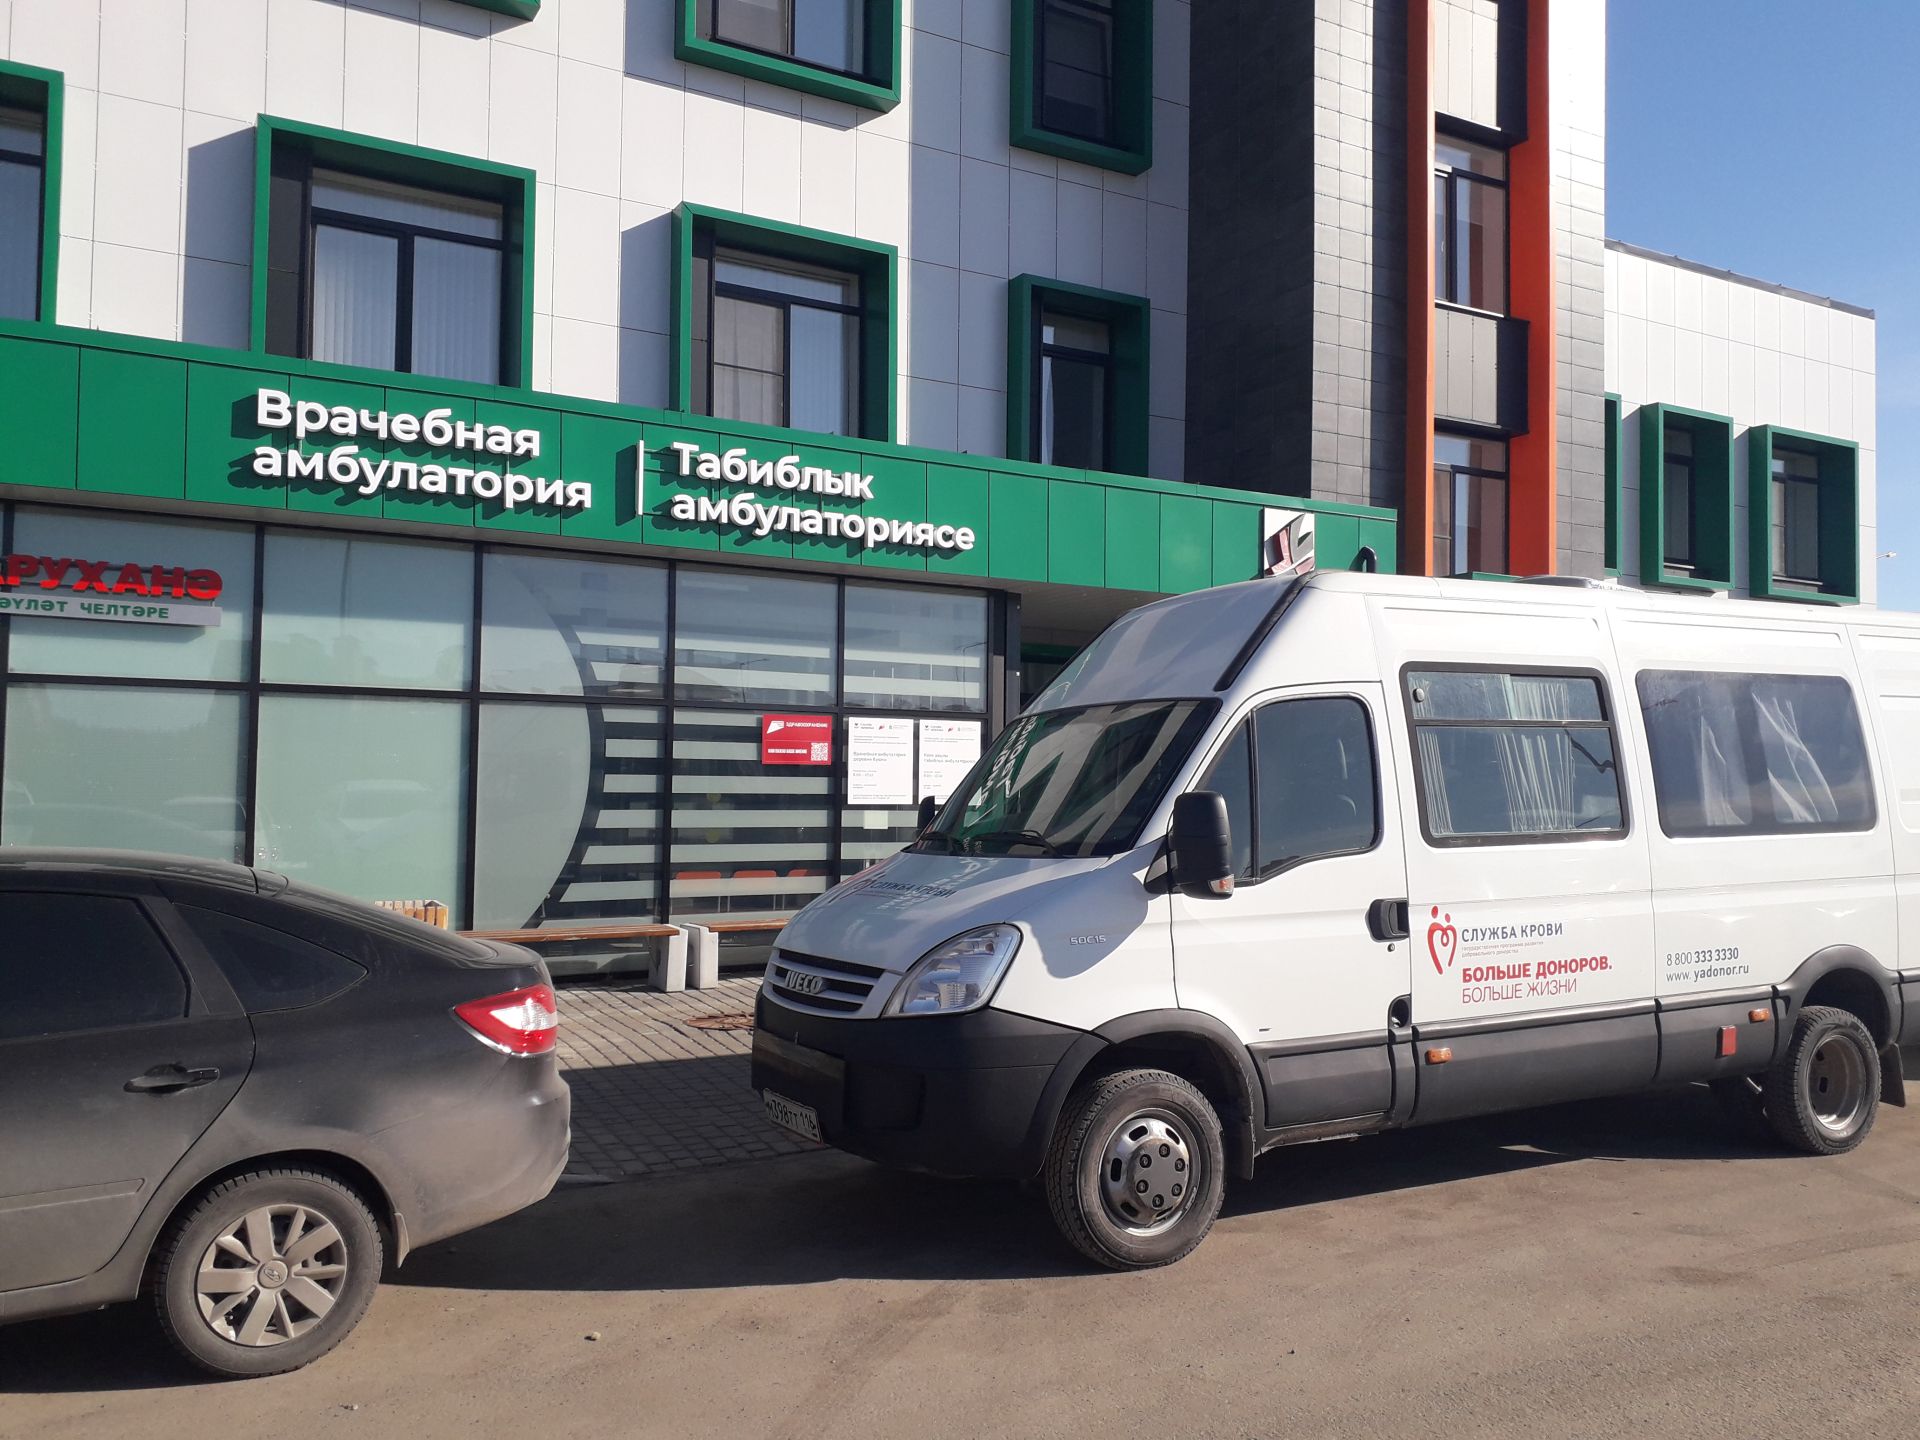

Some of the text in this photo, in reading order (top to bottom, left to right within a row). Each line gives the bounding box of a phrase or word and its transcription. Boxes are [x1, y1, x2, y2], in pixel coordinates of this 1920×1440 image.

[257, 388, 541, 458] Врачебная
[252, 445, 593, 509] амбулатория
[671, 441, 875, 500] Табиблык
[671, 492, 976, 551] амбулаториясе
[0, 554, 223, 600] РУХАНӘ
[80, 602, 169, 618] ЧЕЛТӘРЕ
[1461, 922, 1563, 942] СЛУЖБА КРОВИ
[1462, 956, 1613, 983] БОЛЬШЕ ДОНОРОВ.
[1666, 947, 1739, 966] 8 800 333 3330
[785, 970, 823, 994] IVECO
[1462, 978, 1577, 1004] БОЛЬШЕ ЖИЗНИ
